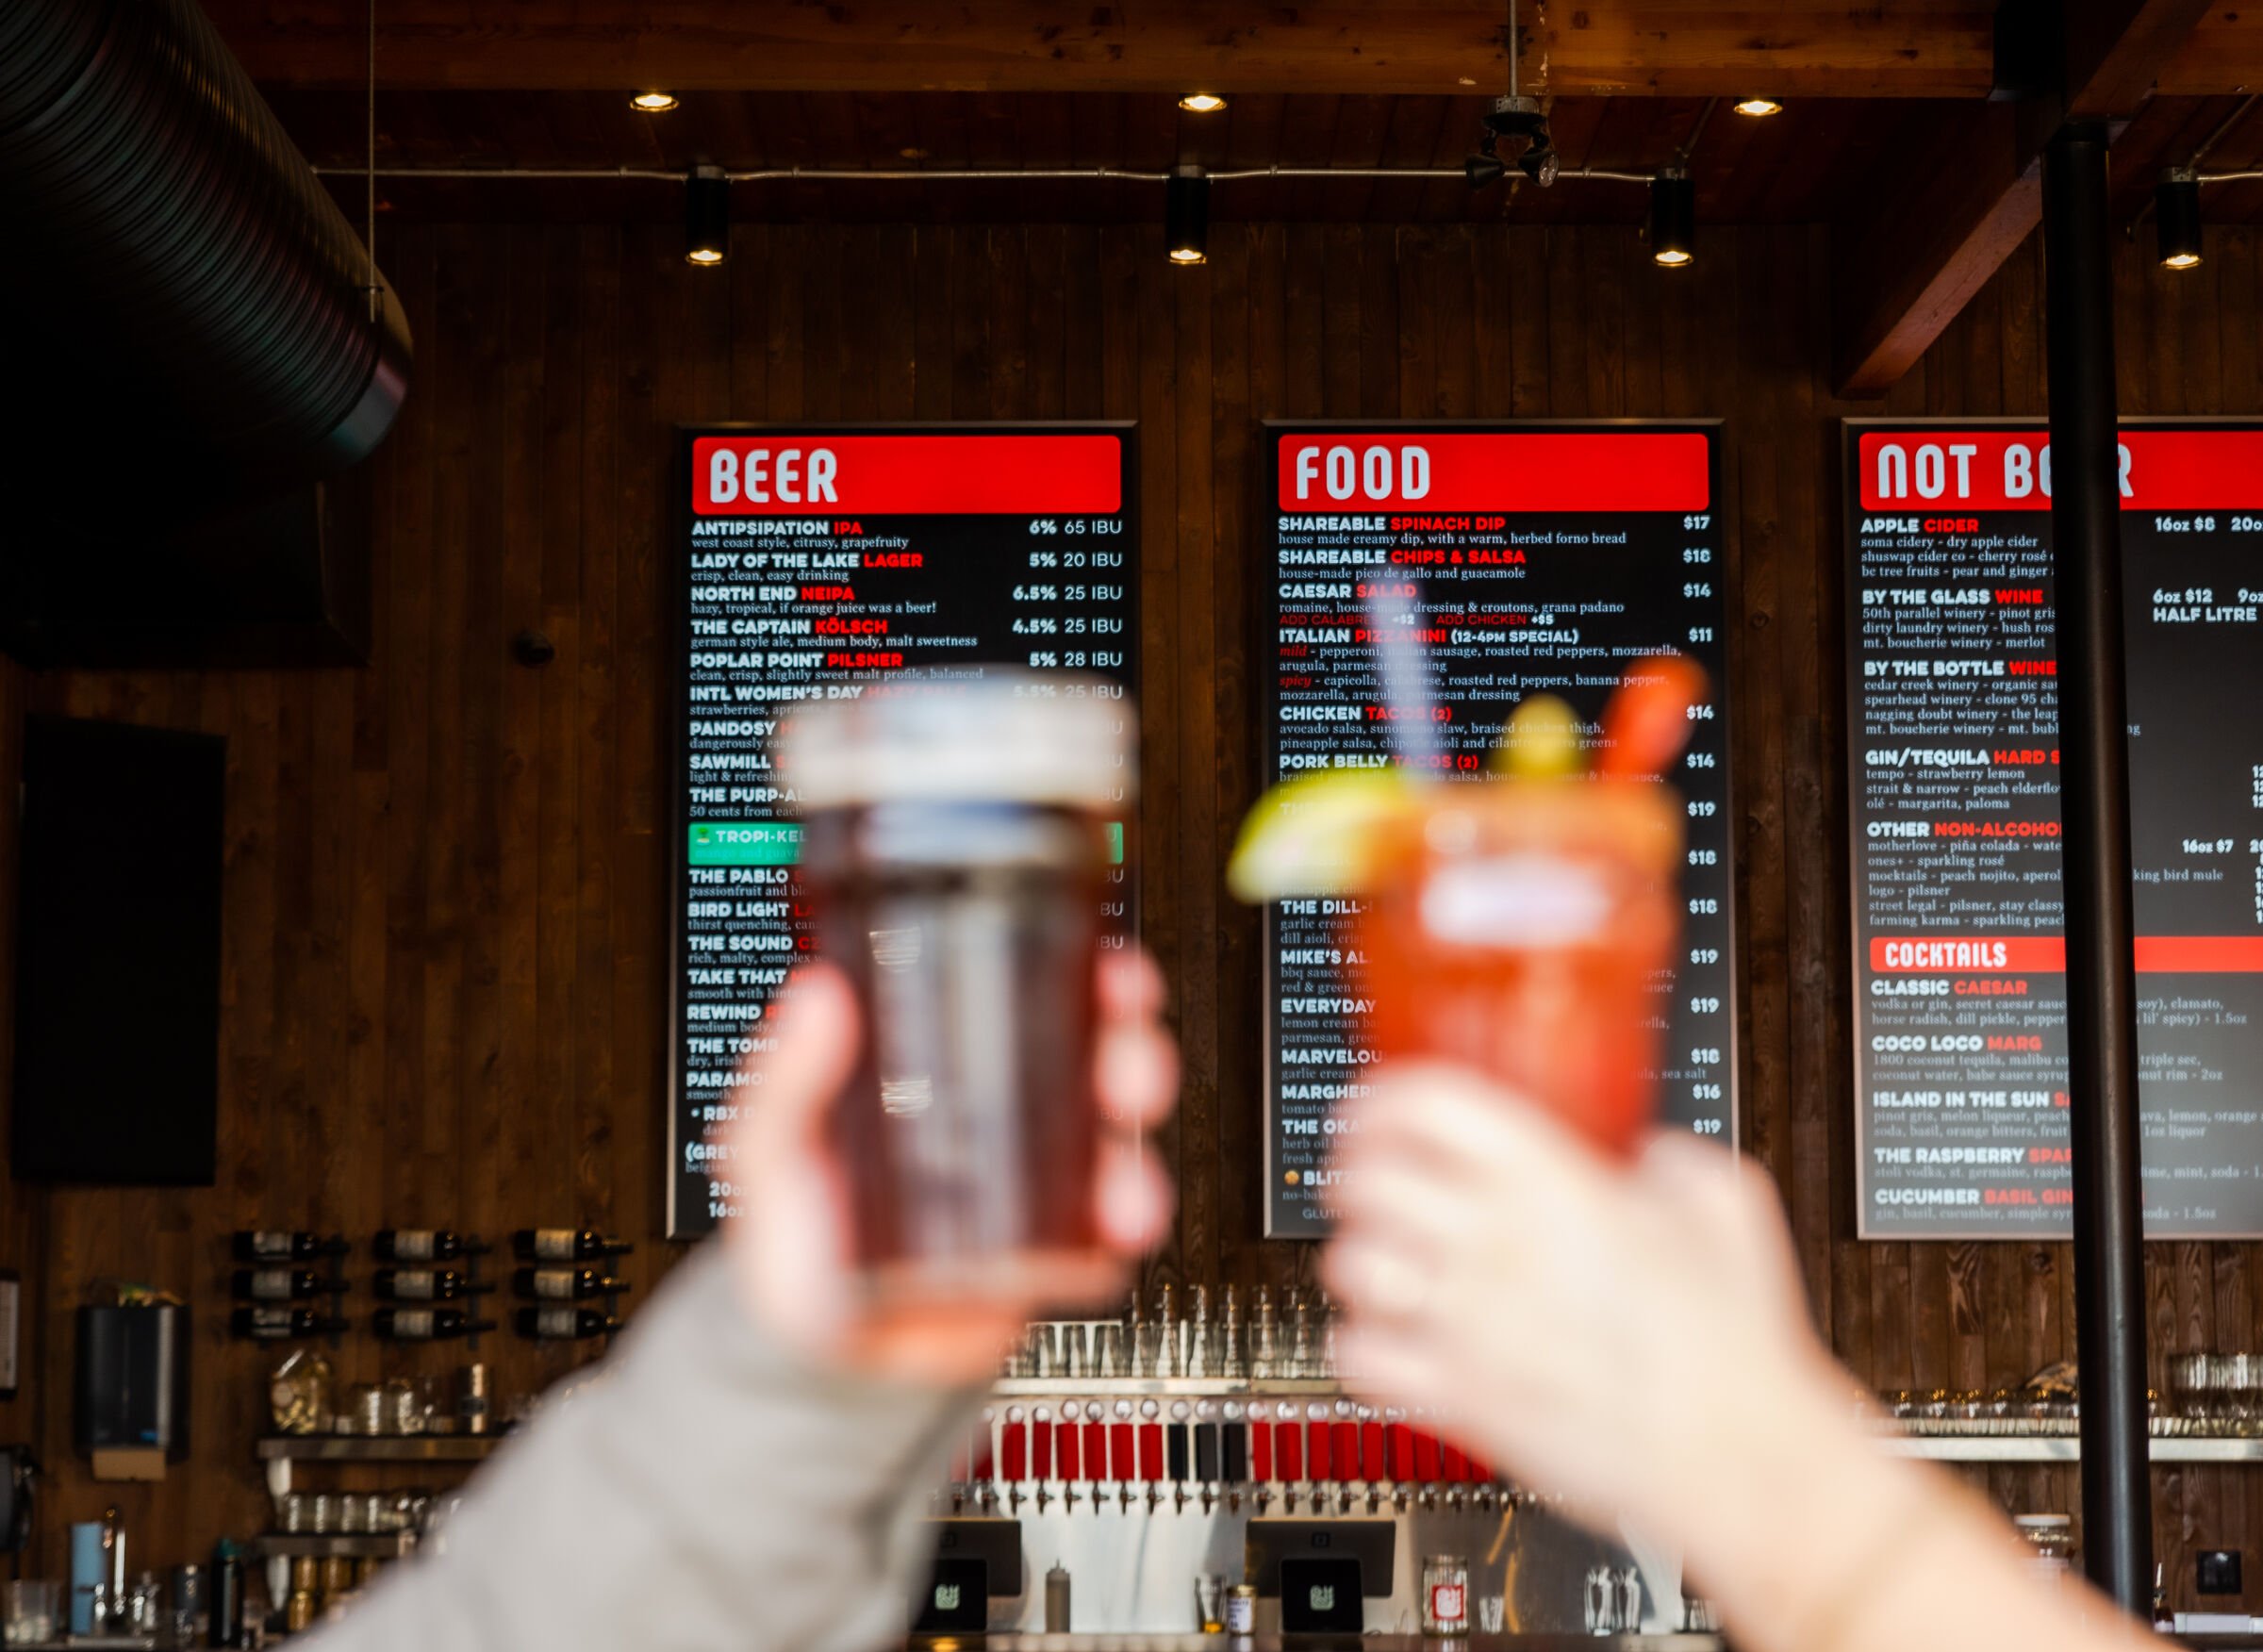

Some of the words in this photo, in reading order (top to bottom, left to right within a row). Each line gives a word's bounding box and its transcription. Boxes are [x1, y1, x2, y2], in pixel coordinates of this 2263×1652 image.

[710, 449, 838, 503] BEER
[1297, 445, 1430, 500] FOOD
[1878, 443, 1976, 499] NOT
[692, 521, 828, 535] ANTIPSIPATION
[834, 521, 863, 535] IPA
[1029, 520, 1057, 535] 6%
[1065, 520, 1085, 534] 65
[1092, 520, 1122, 534] IBU
[1279, 517, 1385, 531] SHAREABLE
[1391, 517, 1470, 531] SPINACH
[1476, 517, 1505, 530] DIP
[1684, 515, 1710, 530] $17
[1860, 519, 1919, 533] APPLE
[1924, 519, 1979, 533] CIDER
[2155, 517, 2189, 532] 16oz
[2194, 517, 2215, 532] $8
[692, 538, 719, 548] west
[723, 537, 753, 548] coast
[757, 536, 790, 549] style,
[793, 536, 838, 549] citrusy,
[841, 536, 909, 549] grapefruity
[1279, 534, 1313, 544] house
[1318, 534, 1349, 544] made
[1353, 536, 1396, 546] creamy
[1401, 533, 1424, 545] dip,
[1428, 533, 1454, 544] with
[1469, 536, 1507, 545] warm,
[1511, 532, 1552, 543] herbed
[1556, 532, 1588, 543] forno
[1592, 532, 1627, 543] bread
[1861, 537, 1892, 547] soma
[1897, 536, 1934, 549] cidery
[1947, 536, 1967, 549] dry
[1972, 536, 2004, 549] apple
[2007, 536, 2039, 547] cider
[691, 553, 740, 568] LADY
[743, 553, 768, 568] OF
[771, 553, 807, 568] THE
[812, 553, 859, 568] LAKE
[864, 553, 922, 567] LAGER
[1030, 553, 1057, 567] 5%
[1064, 553, 1085, 567] 20
[1092, 553, 1122, 567] IBU
[1279, 550, 1385, 564] SHAREABLE
[1391, 550, 1445, 564] CHIPS
[1450, 550, 1462, 563] &
[1468, 550, 1526, 563] SALSA
[1683, 549, 1710, 563] $18
[691, 570, 725, 583] crisp,
[728, 570, 764, 582] clean,
[767, 572, 793, 583] easy
[798, 570, 849, 583] drinking
[691, 587, 754, 601] NORTH
[759, 586, 796, 601] END
[801, 586, 854, 601] NEIPA
[1013, 586, 1057, 600] 6.5%
[1065, 586, 1085, 600] 25
[1092, 586, 1122, 600] IBU
[1280, 584, 1351, 598] CAESAR
[1357, 584, 1417, 598] SALAD
[1683, 583, 1711, 598] $14
[1862, 590, 1886, 604] BY
[1890, 590, 1926, 604] THE
[1931, 589, 1990, 604] GLASS
[1995, 589, 2043, 604] WINE
[2153, 588, 2181, 603] 6oz
[2186, 588, 2212, 603] $12
[1436, 615, 1463, 624] ADD
[1468, 615, 1527, 624] CHICKEN
[2153, 607, 2200, 622] HALF
[2205, 607, 2257, 622] LITRE
[691, 620, 727, 634] THE
[732, 620, 811, 634] CAPTAIN
[815, 618, 887, 634] KÖLSCH
[1012, 619, 1057, 634] 4.5%
[1065, 619, 1085, 634] 25
[1092, 619, 1122, 633] IBU
[1280, 629, 1350, 643] ITALIAN
[1510, 628, 1578, 644] SPECIAL)
[1689, 628, 1712, 643] $11
[691, 653, 763, 668] POPLAR
[768, 653, 823, 668] POINT
[828, 653, 903, 668] PILSNER
[1030, 653, 1057, 667] 5%
[1065, 653, 1085, 667] 28
[1092, 653, 1122, 667] IBU
[1864, 661, 1889, 675] BY
[1892, 661, 1928, 675] THE
[1933, 661, 2004, 675] BOTTLE
[2009, 661, 2057, 675] WINE
[689, 686, 732, 701] INTL
[735, 686, 822, 701] WOMEN'S
[828, 686, 863, 699] DAY
[1280, 706, 1361, 719] CHICKEN
[1687, 705, 1713, 719] $14
[689, 721, 776, 735] PANDOSY
[689, 754, 770, 769] SAWMILL
[1280, 755, 1329, 768] PORK
[1334, 755, 1388, 768] BELLY
[1457, 755, 1478, 769] (2)
[1687, 754, 1714, 768] $14
[1865, 747, 1990, 768] GIN/TEQUILA
[1994, 751, 2045, 764] HARD
[1688, 801, 1716, 817] $19
[1898, 800, 1961, 811] margarita,
[1966, 800, 2009, 811] paloma
[1867, 821, 1929, 837] OTHER
[2183, 839, 2213, 853] 16oz
[2216, 839, 2234, 853] $7
[1689, 851, 1716, 866] $18
[688, 869, 725, 884] THE
[730, 869, 788, 884] PABLO
[688, 902, 732, 917] BIRD
[735, 902, 789, 917] LIGHT
[1280, 900, 1317, 914] THE
[1690, 900, 1717, 914] $18
[688, 935, 725, 950] THE
[729, 935, 793, 950] SOUND
[1280, 950, 1341, 965] MIKE'S
[1691, 950, 1718, 964] $19
[1886, 942, 2007, 967] COCKTAILS
[688, 969, 735, 984] TAKE
[738, 969, 786, 984] THAT
[1871, 980, 1949, 996] CLASSIC
[1954, 981, 2026, 995] CAESAR
[687, 1005, 761, 1020] REWIND
[1281, 999, 1376, 1013] EVERYDAY
[1691, 998, 1719, 1013] $19
[1872, 1036, 1926, 1051] COCO
[1931, 1035, 1983, 1051] LOCO
[1988, 1036, 2041, 1051] MARG
[1692, 1049, 1720, 1064] $18
[1693, 1084, 1721, 1099] $16
[1874, 1092, 1941, 1108] ISLAND
[1946, 1092, 1965, 1108] IN
[1969, 1092, 2007, 1107] THE
[2011, 1092, 2049, 1107] SUN
[1693, 1119, 1721, 1133] $19
[1875, 1148, 1911, 1164] THE
[1915, 1148, 2024, 1164] RASPBERRY
[1875, 1189, 1979, 1204] CUCUMBER
[1984, 1189, 2037, 1204] BASIL
